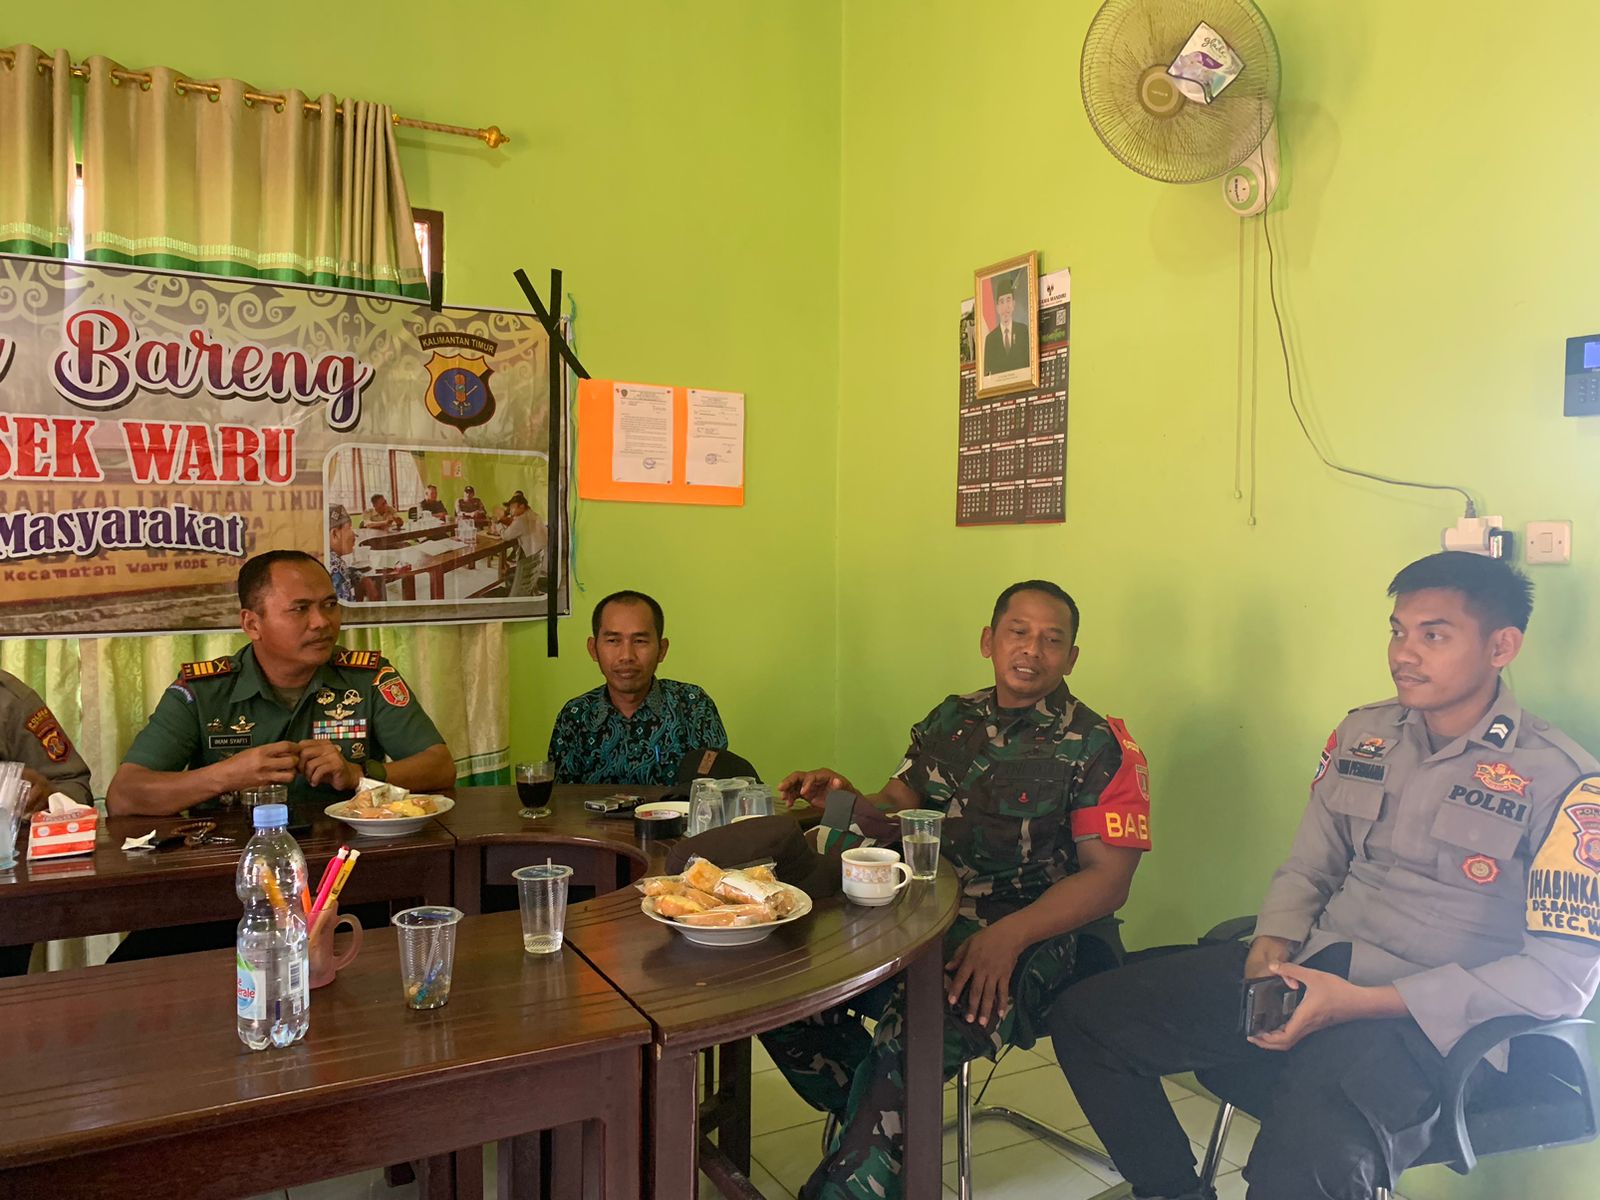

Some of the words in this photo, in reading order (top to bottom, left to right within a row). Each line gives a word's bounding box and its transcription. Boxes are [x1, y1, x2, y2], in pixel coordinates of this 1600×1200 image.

[421, 336, 470, 348] KALIMANTAN
[471, 339, 495, 354] TIMUR
[54, 308, 368, 424] Bareng
[122, 422, 295, 482] WARU
[263, 490, 323, 511] TIMU
[4, 564, 116, 582] Kecamatan
[174, 558, 208, 570] KODE
[1448, 785, 1527, 822] POLRI
[1105, 812, 1148, 840] BAB
[1543, 912, 1585, 932] KEC.
